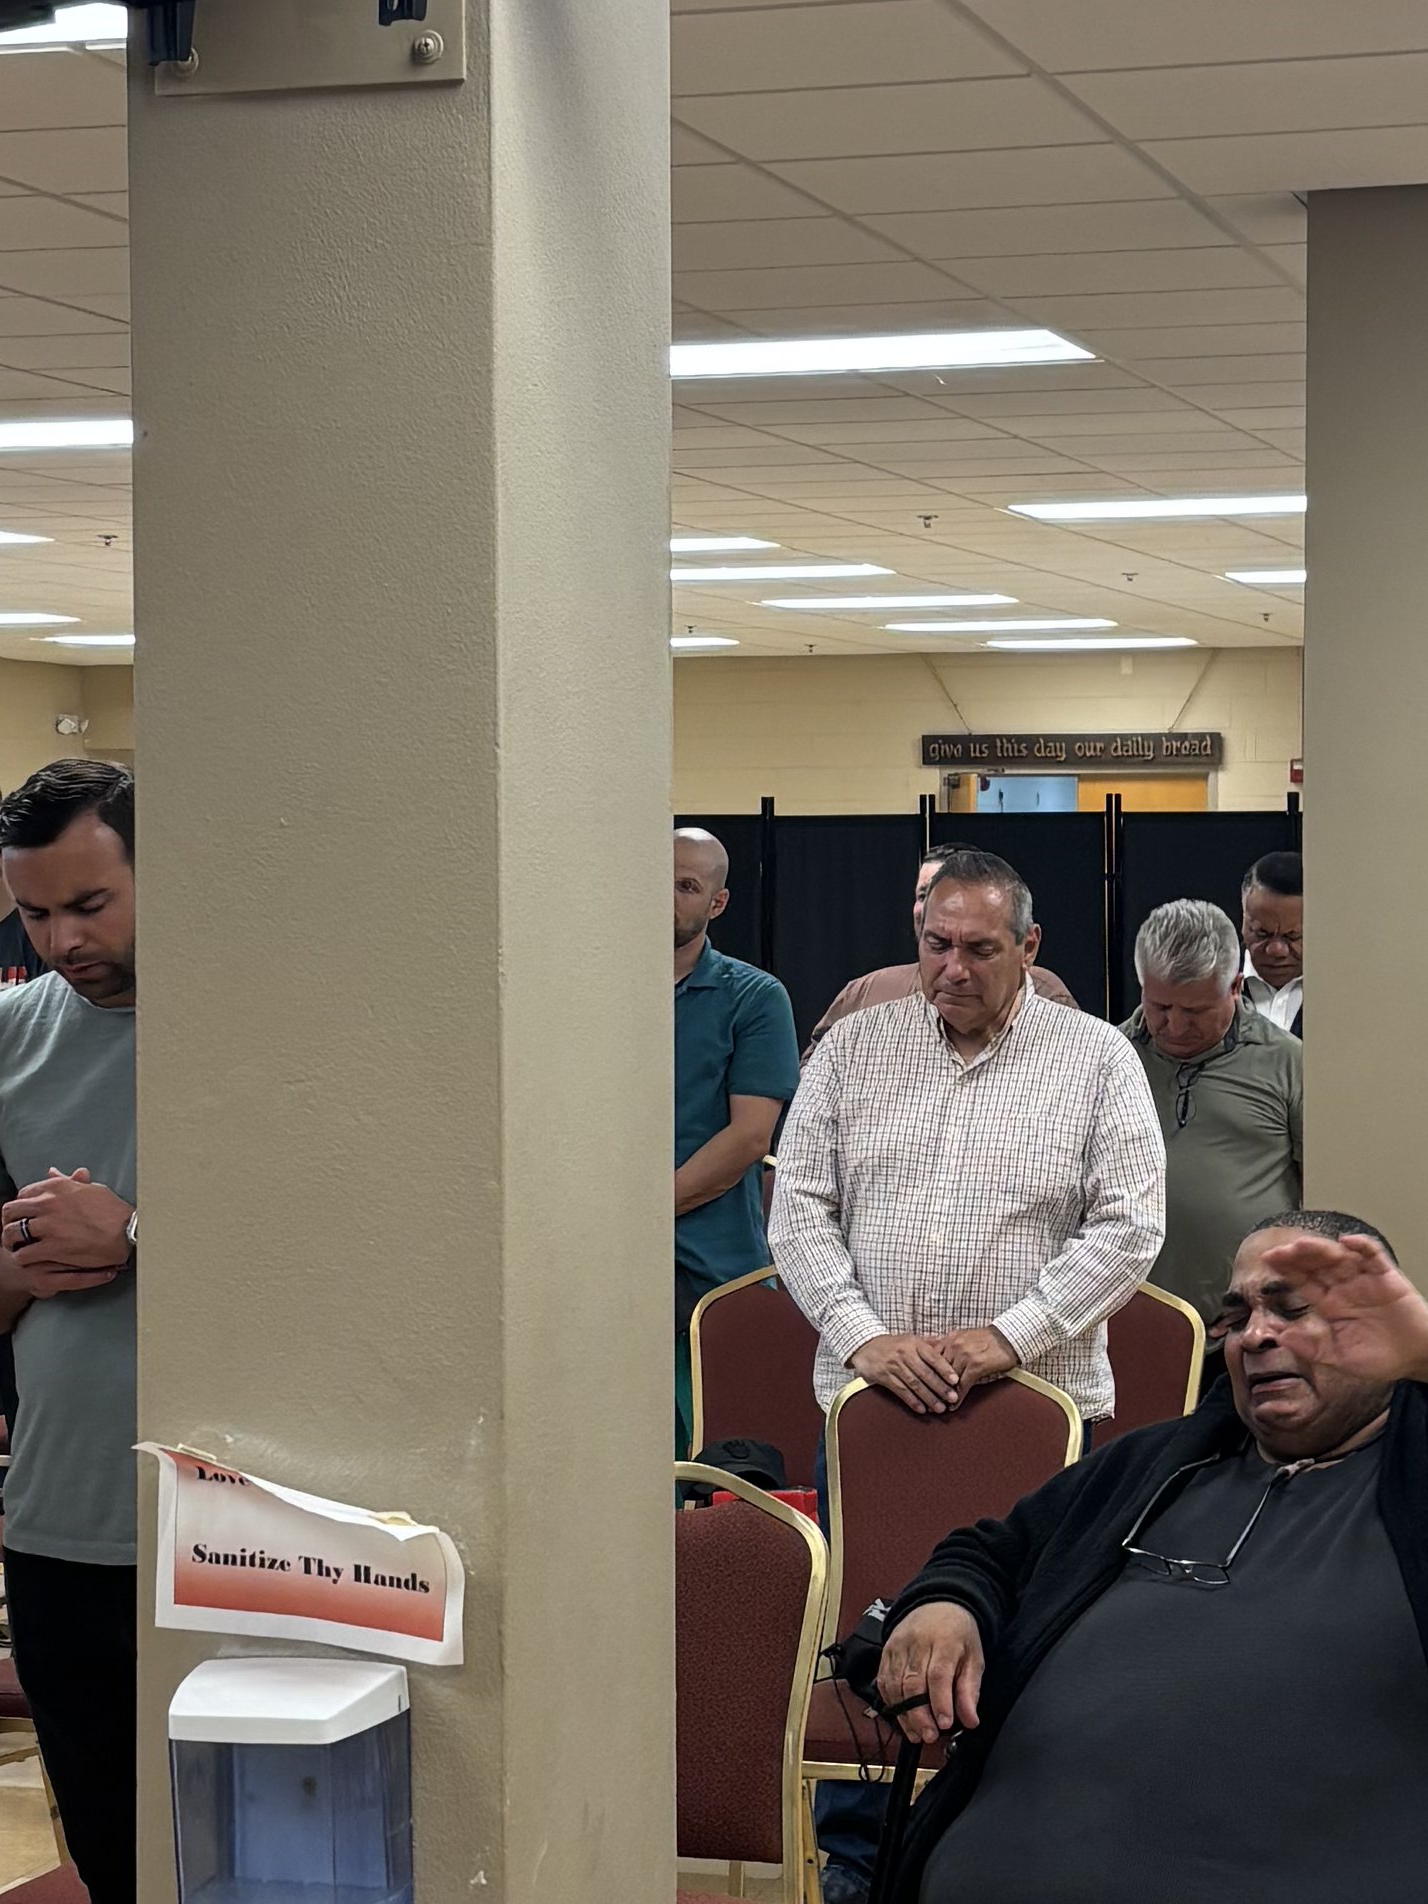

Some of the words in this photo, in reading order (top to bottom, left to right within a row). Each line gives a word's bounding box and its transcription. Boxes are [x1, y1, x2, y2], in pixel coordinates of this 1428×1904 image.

[929, 739, 963, 761] give
[969, 743, 989, 758] us
[995, 737, 1028, 758] this
[1033, 737, 1066, 761] day
[1074, 741, 1104, 757] our
[1110, 736, 1154, 761] daily
[1162, 735, 1212, 757] bread
[191, 1543, 291, 1573] Sanitize
[298, 1555, 345, 1585] Thy
[353, 1563, 431, 1594] Hands
